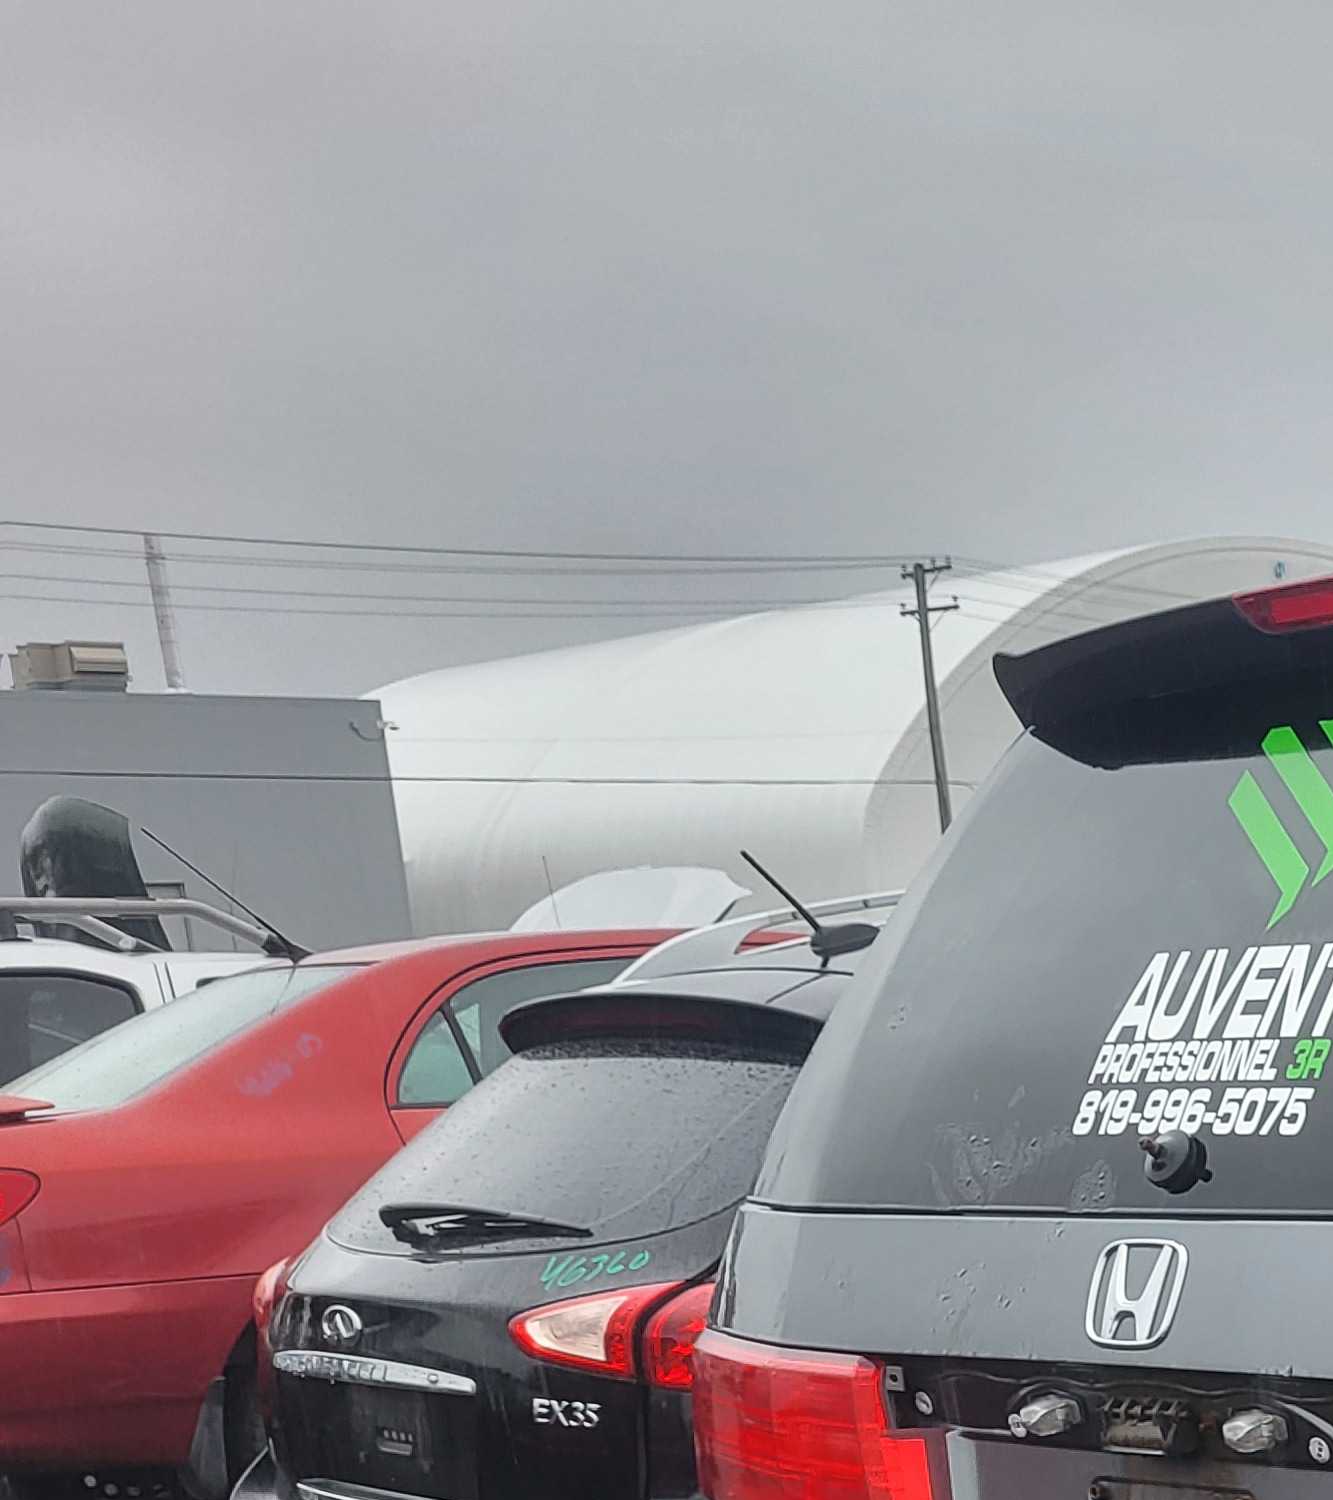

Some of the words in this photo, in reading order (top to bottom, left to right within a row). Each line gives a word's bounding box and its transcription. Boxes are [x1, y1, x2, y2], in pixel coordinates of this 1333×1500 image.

[1088, 1038, 1281, 1084] PROFESSIONNEL
[1286, 1038, 1332, 1080] 3R
[1071, 1086, 1315, 1137] 819-996-5075
[539, 1249, 652, 1291] 46360
[532, 1398, 603, 1428] EX35
